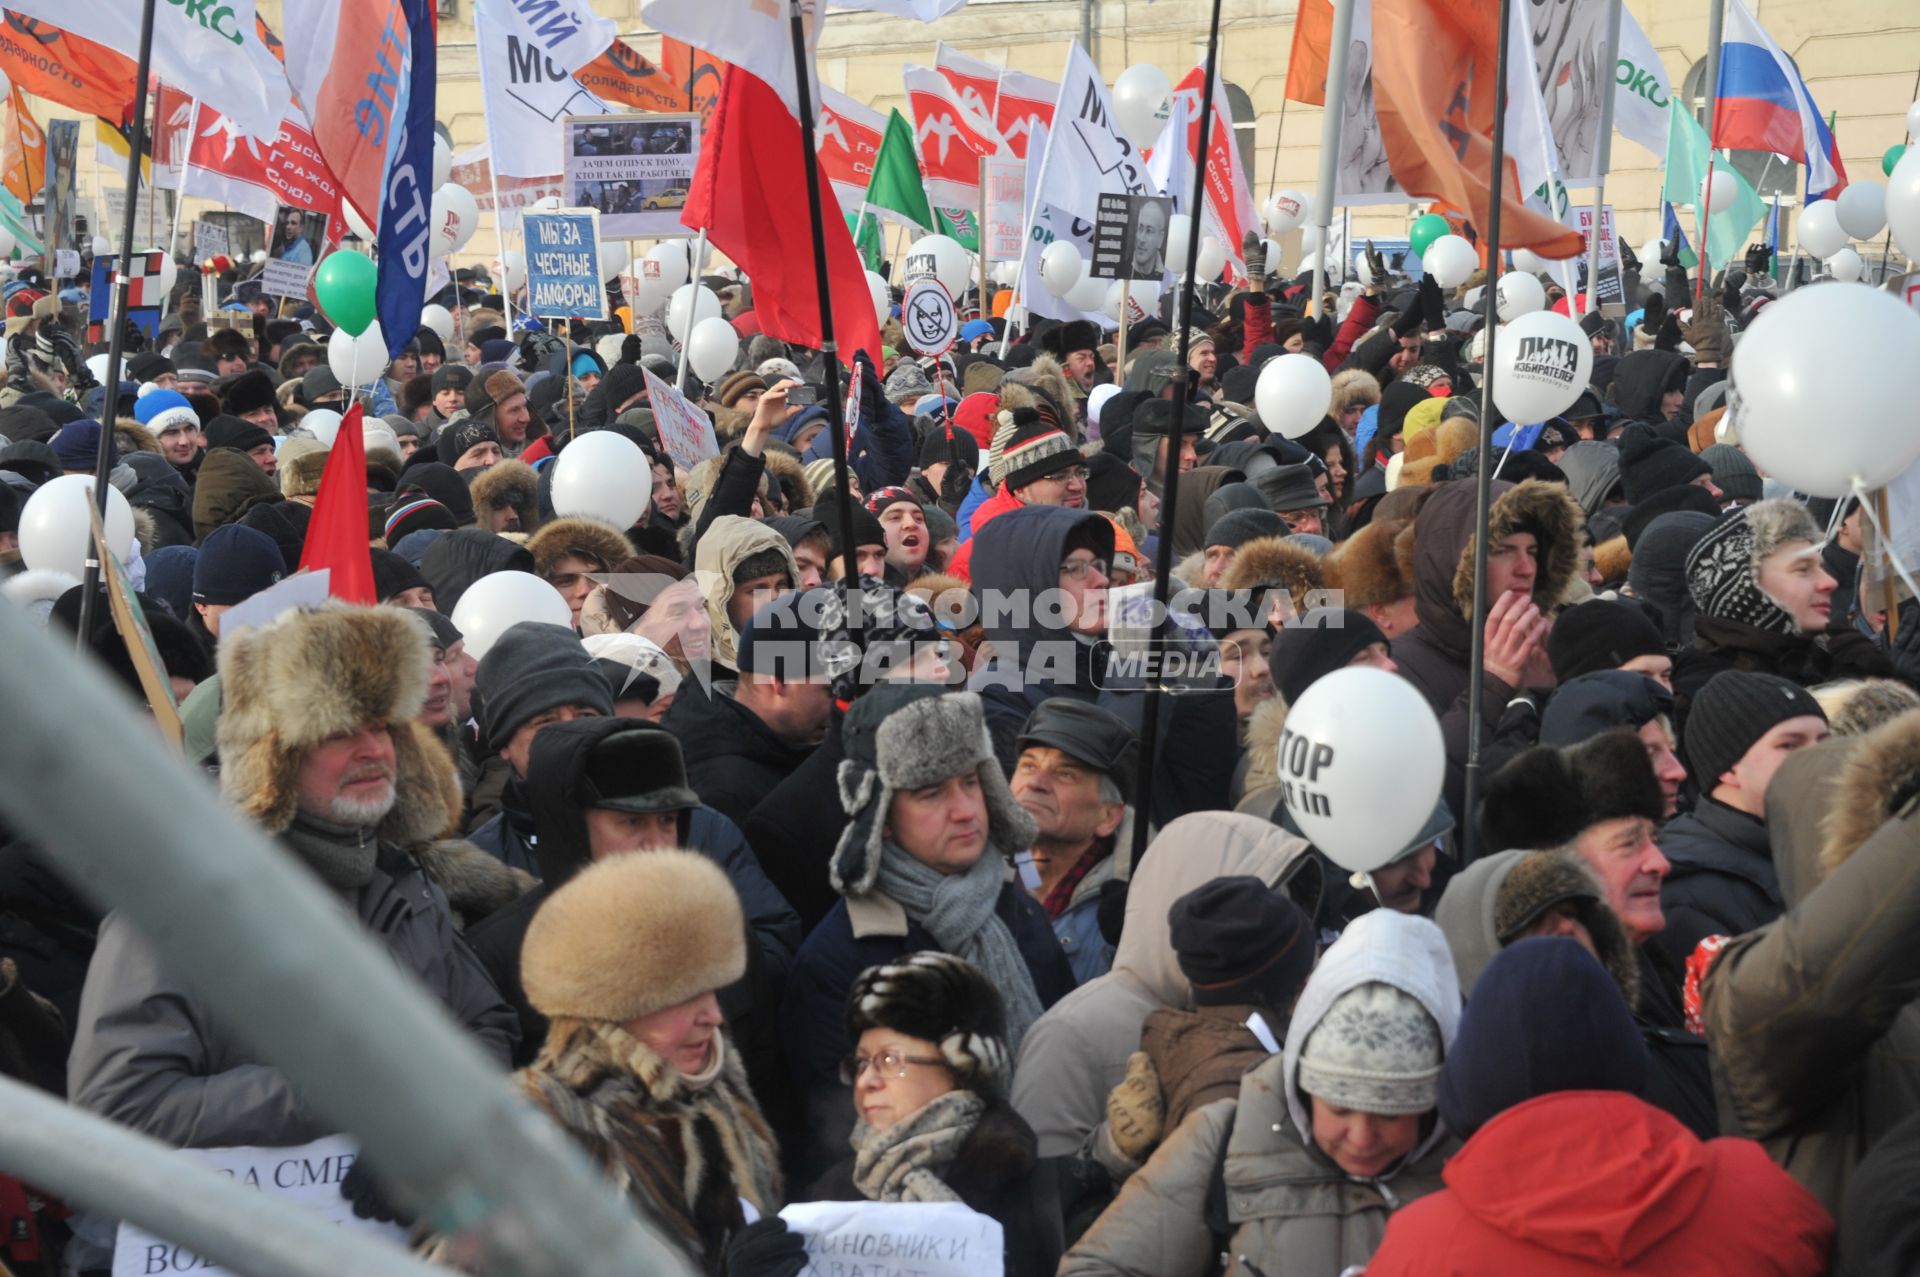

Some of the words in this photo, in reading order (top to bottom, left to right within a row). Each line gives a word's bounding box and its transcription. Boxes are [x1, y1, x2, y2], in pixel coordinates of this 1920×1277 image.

[512, 0, 582, 49] ИЙ
[576, 171, 595, 179] КТО
[596, 171, 603, 179] И
[605, 171, 624, 179] ТАК
[626, 170, 638, 178] НЕ
[583, 160, 613, 168] ЗАЧЕМ
[615, 159, 653, 168] ОТПУСК
[539, 221, 560, 244] МЫ
[562, 222, 582, 245] ЗА
[535, 253, 591, 276] ЧЕСТНЫЕ
[1514, 362, 1575, 384] ИЗБИРАТЕЛЕЙ
